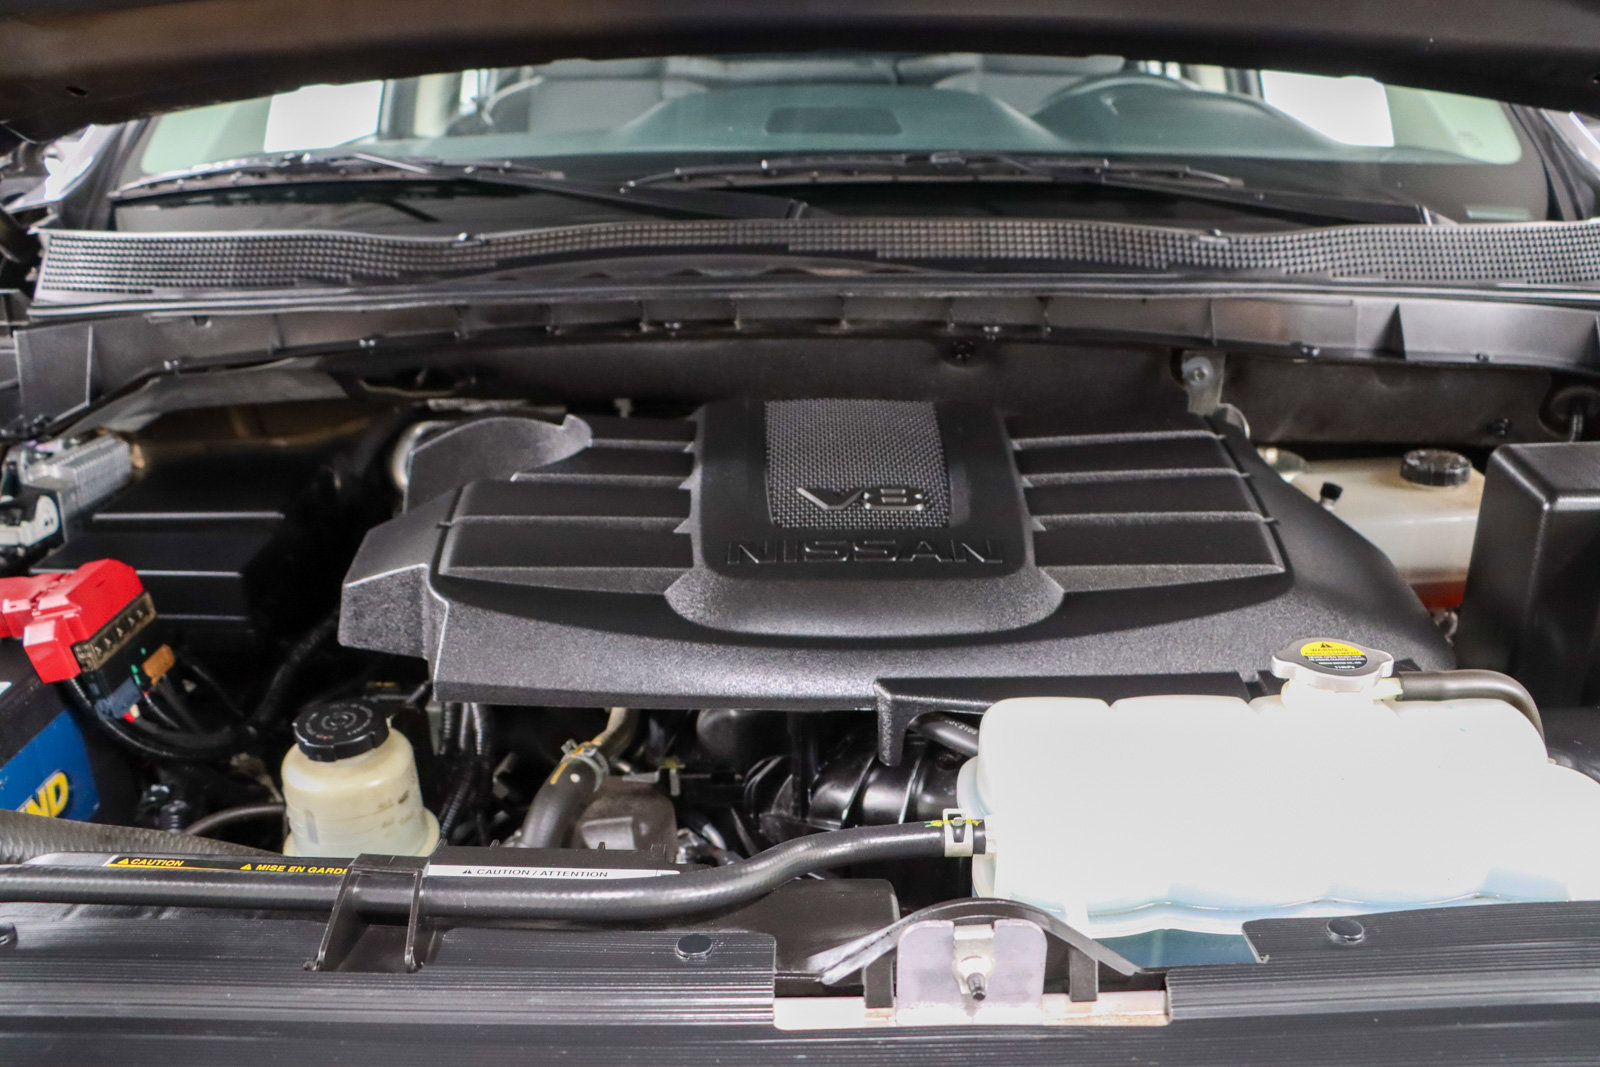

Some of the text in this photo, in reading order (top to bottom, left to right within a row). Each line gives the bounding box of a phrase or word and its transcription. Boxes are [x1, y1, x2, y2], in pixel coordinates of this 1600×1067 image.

[797, 487, 924, 511] V8
[727, 540, 1003, 564] NISSAN
[130, 858, 184, 867] CAUTION
[255, 864, 287, 872] MISE
[287, 865, 306, 873] EN
[476, 868, 531, 876] CAUTION
[540, 870, 608, 878] ATTENTION
